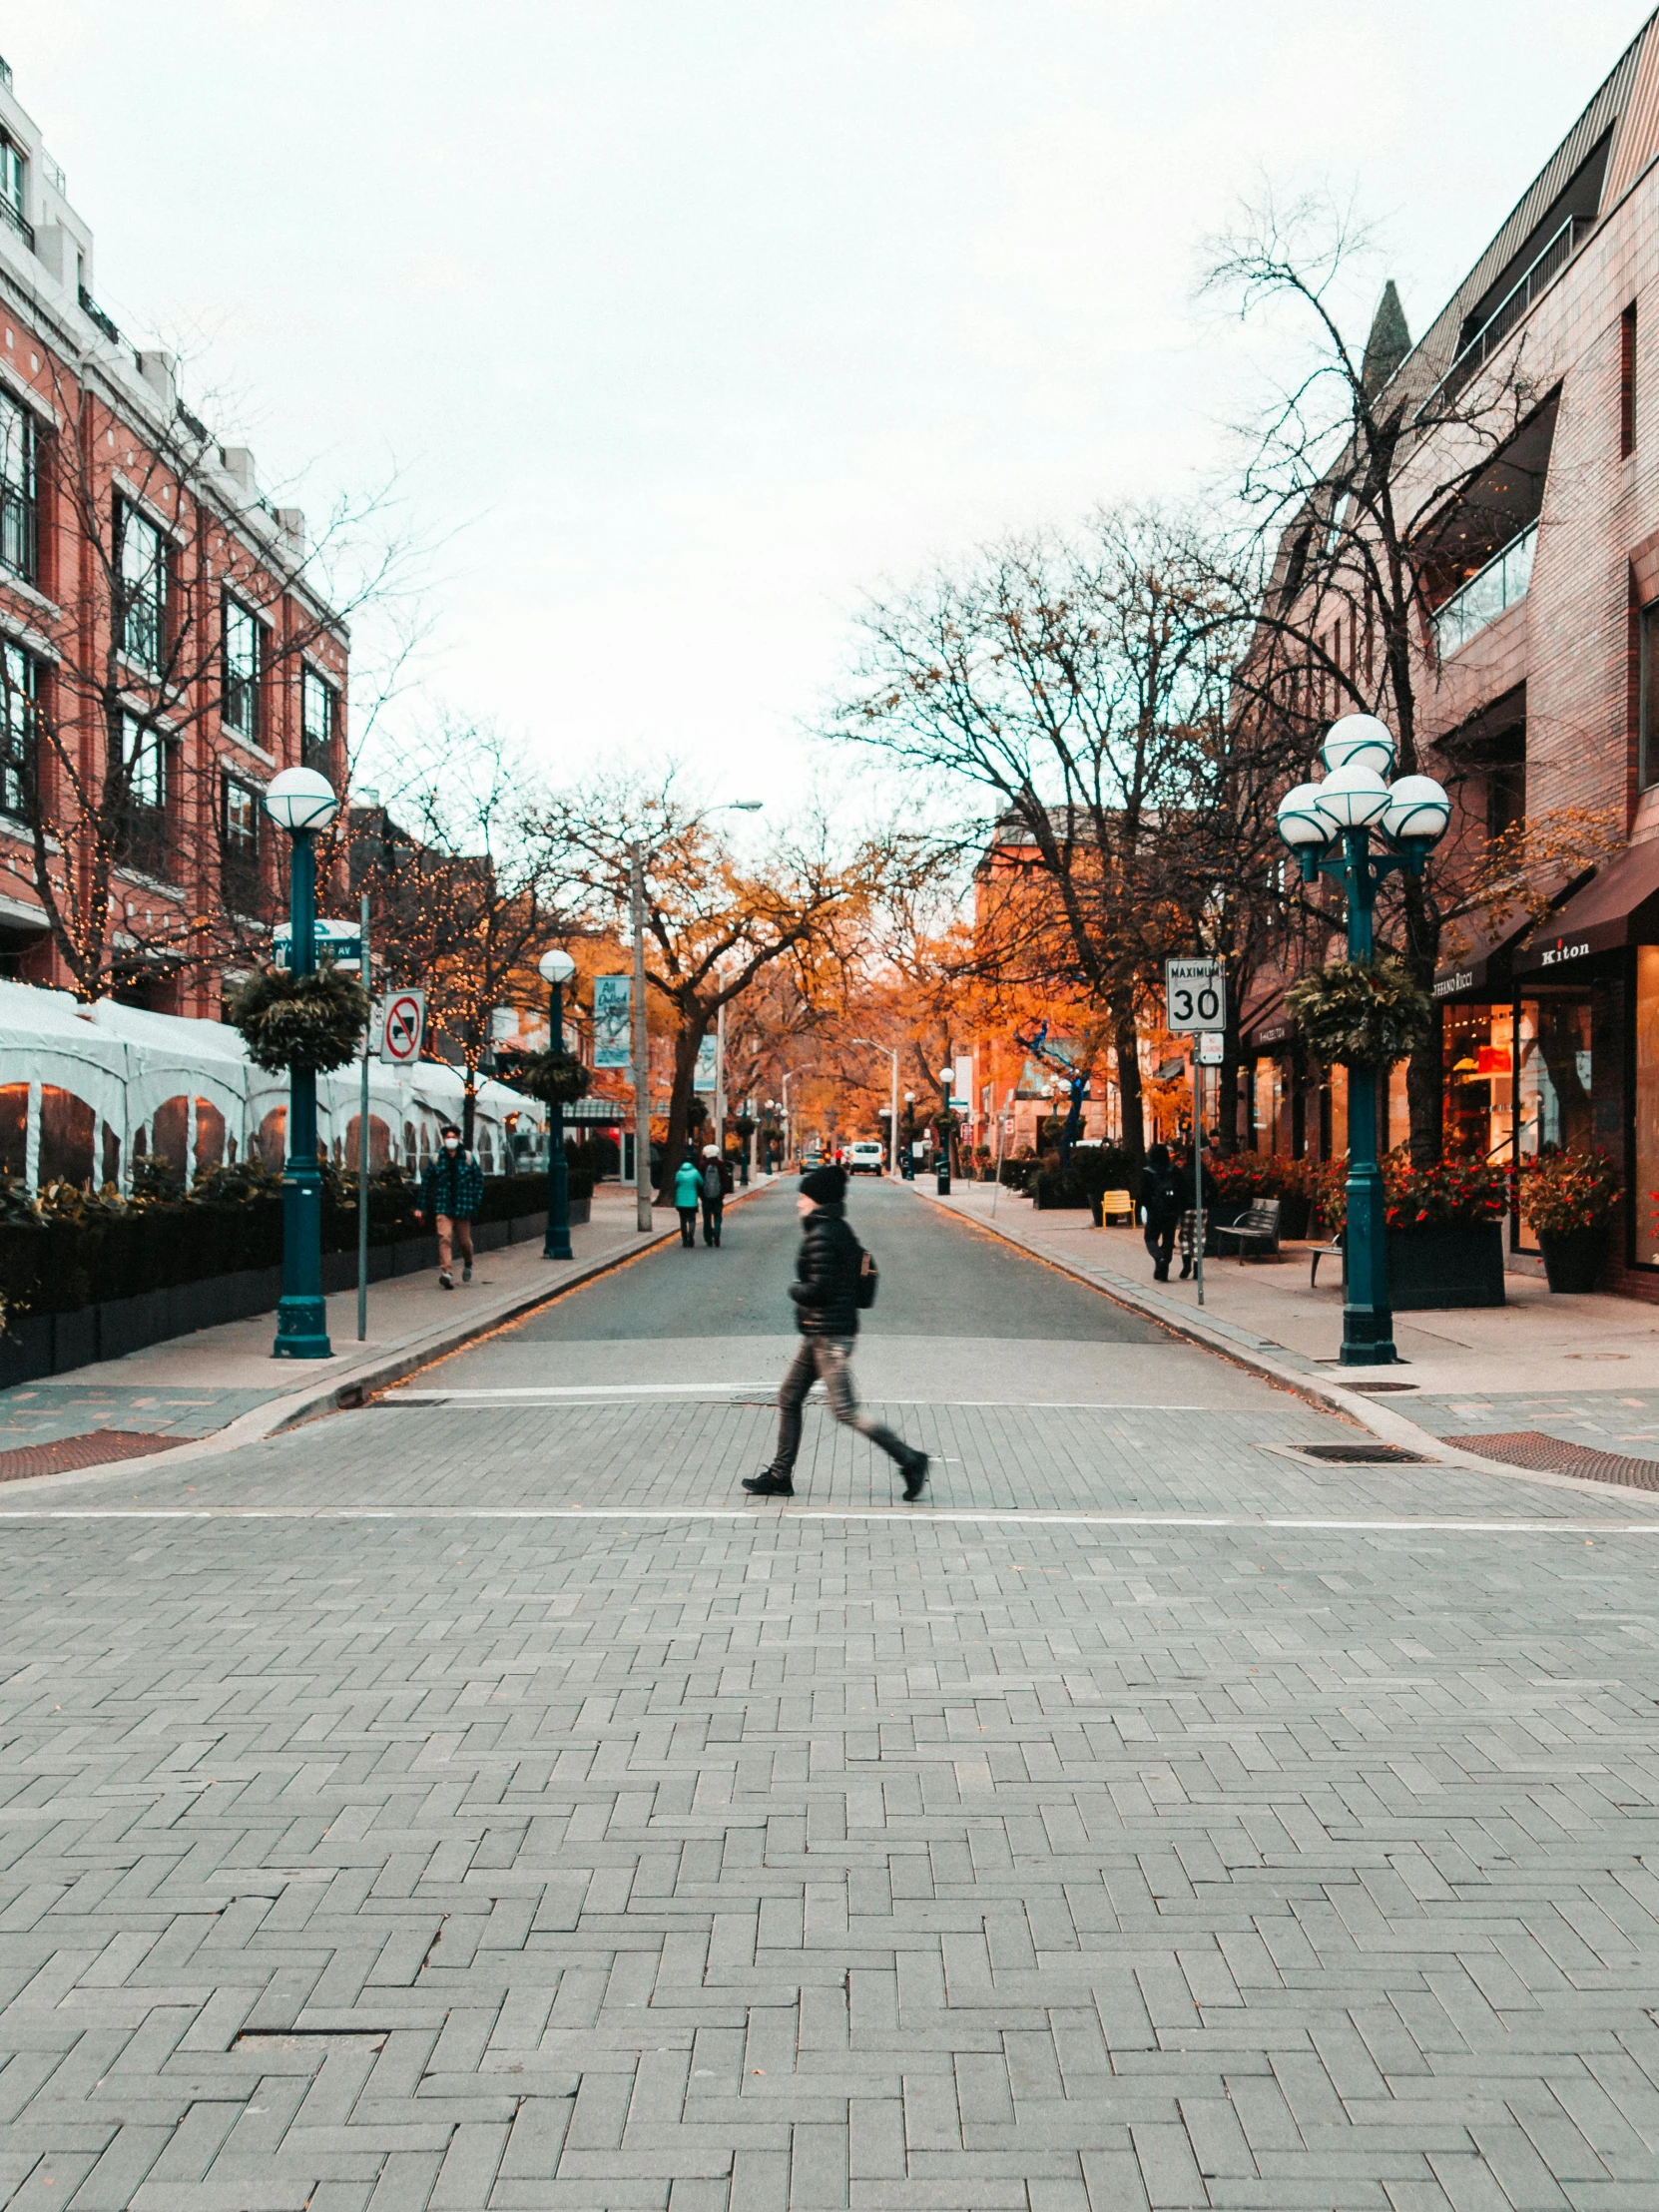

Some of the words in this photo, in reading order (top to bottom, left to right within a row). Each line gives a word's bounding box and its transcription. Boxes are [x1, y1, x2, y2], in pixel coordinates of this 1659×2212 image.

[337, 946, 351, 955] AV
[1541, 939, 1590, 966] Kiton
[1171, 967, 1220, 978] MAXIMUM
[1433, 978, 1455, 996] TEFANO
[1173, 989, 1220, 1020] 30
